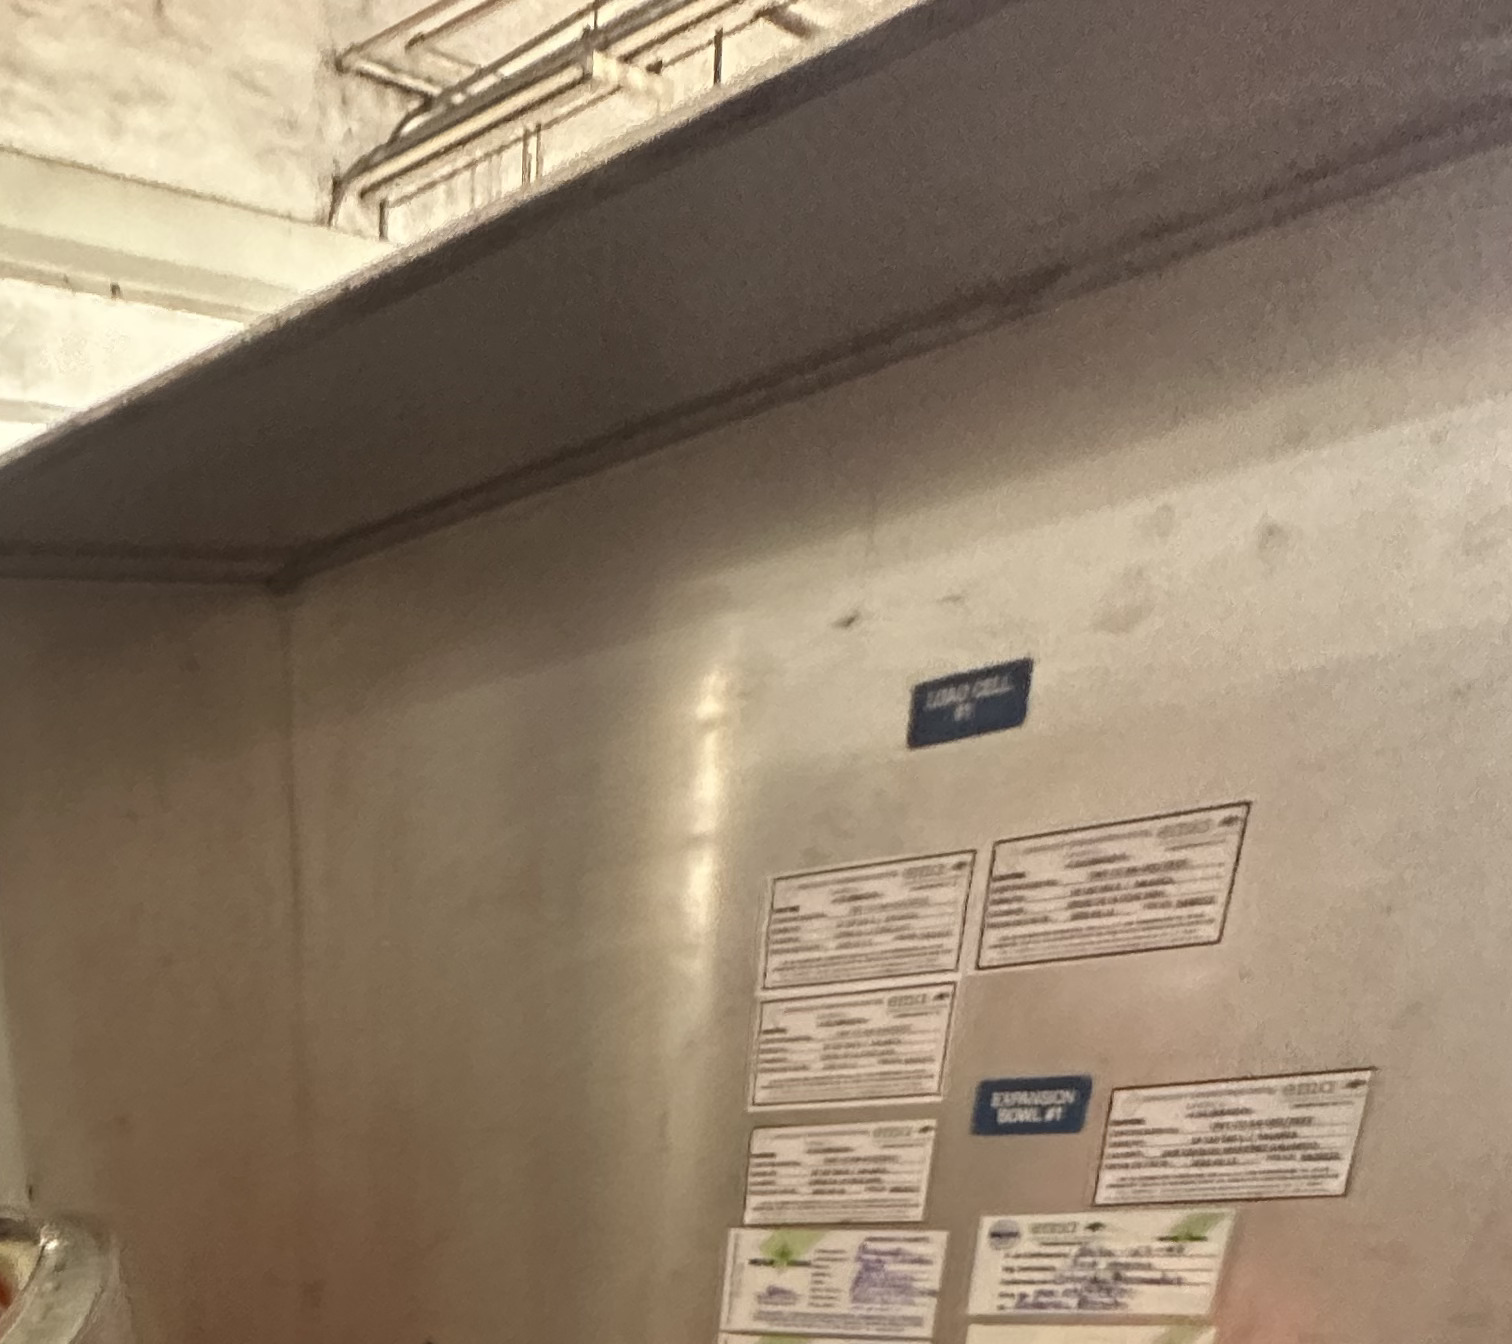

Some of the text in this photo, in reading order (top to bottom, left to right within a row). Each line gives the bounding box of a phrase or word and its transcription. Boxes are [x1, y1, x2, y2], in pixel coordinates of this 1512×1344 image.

[990, 1087, 1077, 1109] EXPANSION
[996, 1105, 1064, 1125] BOWL #1
